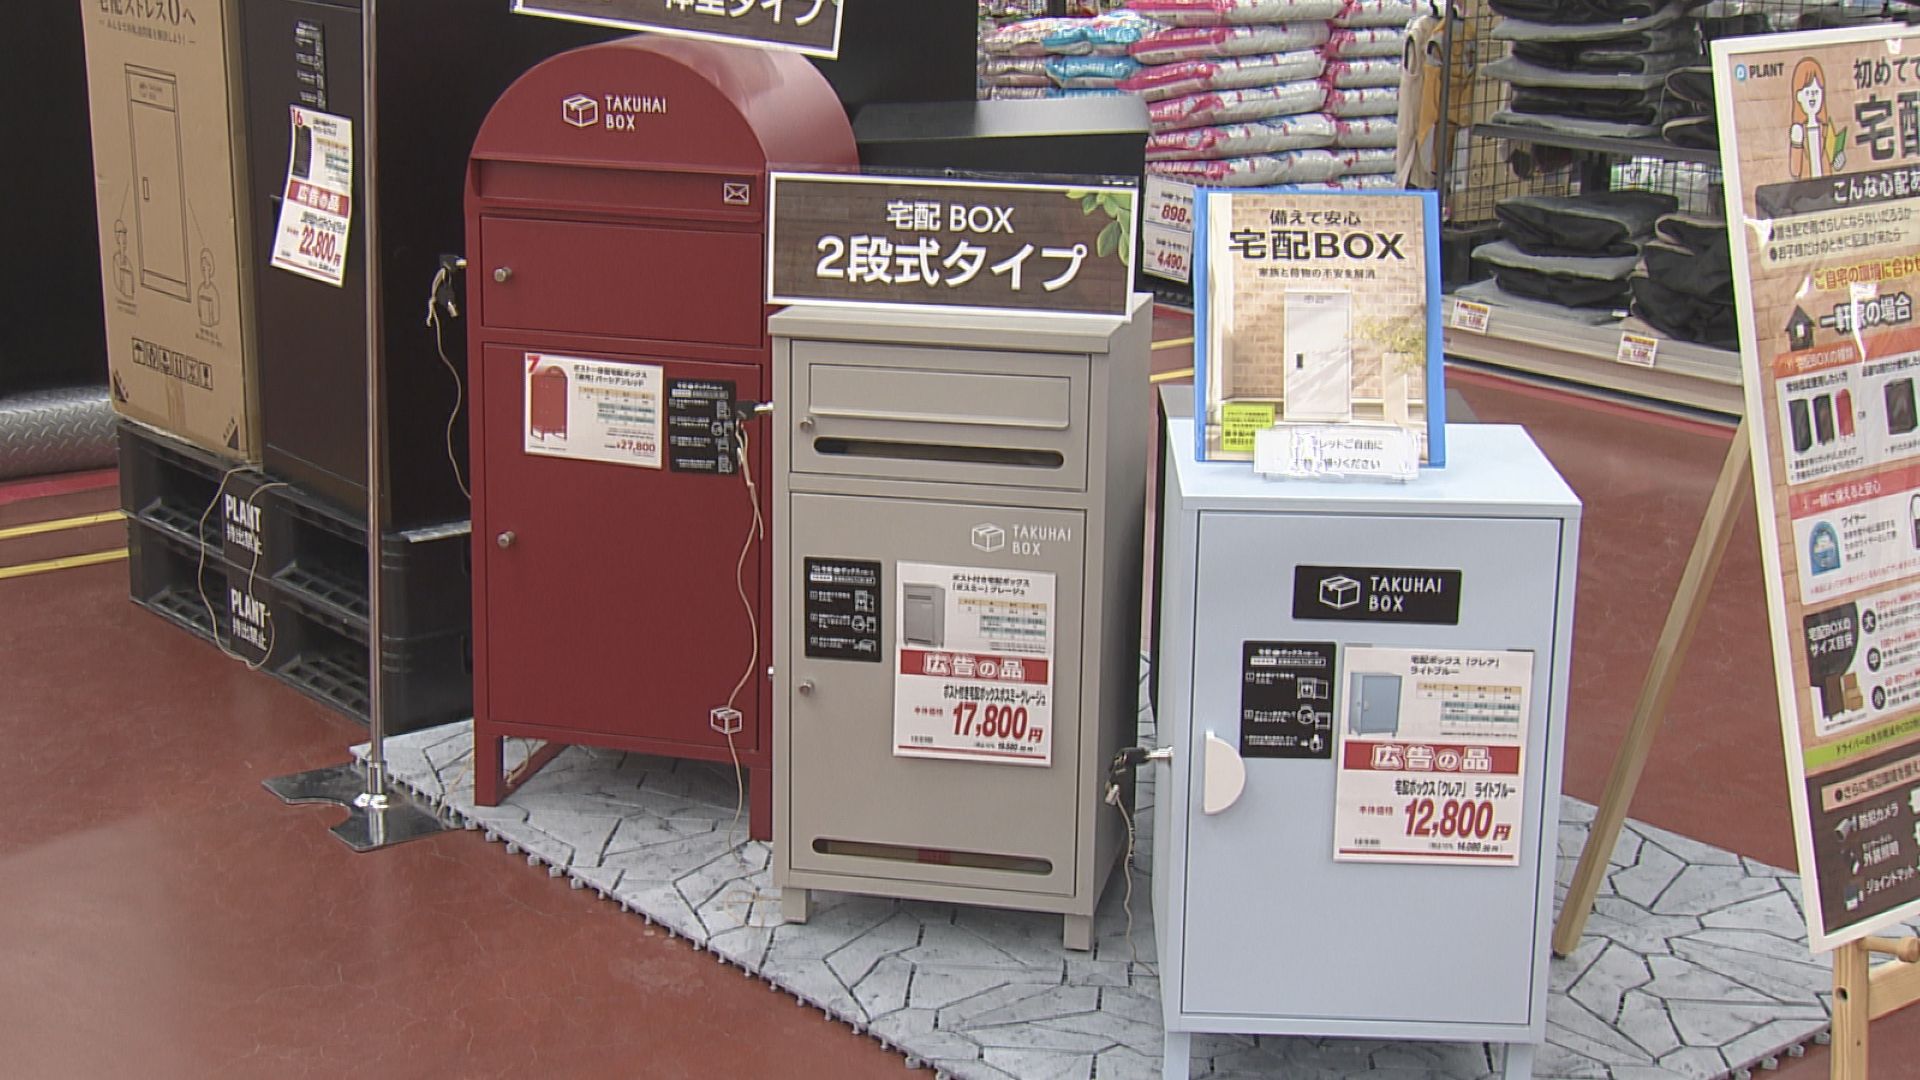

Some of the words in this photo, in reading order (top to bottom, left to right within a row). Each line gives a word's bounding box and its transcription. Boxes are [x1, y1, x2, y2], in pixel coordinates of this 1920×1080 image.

[1750, 62, 1785, 78] PLANT
[604, 94, 666, 113] TAKUHAI
[605, 113, 635, 131] BOX
[887, 199, 942, 231] 宅配
[949, 206, 1016, 234] BOX
[1269, 209, 1362, 226] 備えて安心
[1228, 228, 1406, 260] 宅配BOX
[816, 234, 1088, 292] 2段式タイプ
[527, 355, 542, 374] 7
[224, 493, 262, 532] PLANT
[1012, 524, 1072, 542] TAKUHAI
[1012, 541, 1041, 556] BOX
[1370, 576, 1442, 593] TAKUHAI
[230, 588, 267, 628] PLANT
[1368, 594, 1404, 613] BOX
[924, 652, 1023, 682] 広告の品
[1410, 667, 1459, 676] ライトブルー
[1372, 744, 1491, 772] 広告の品
